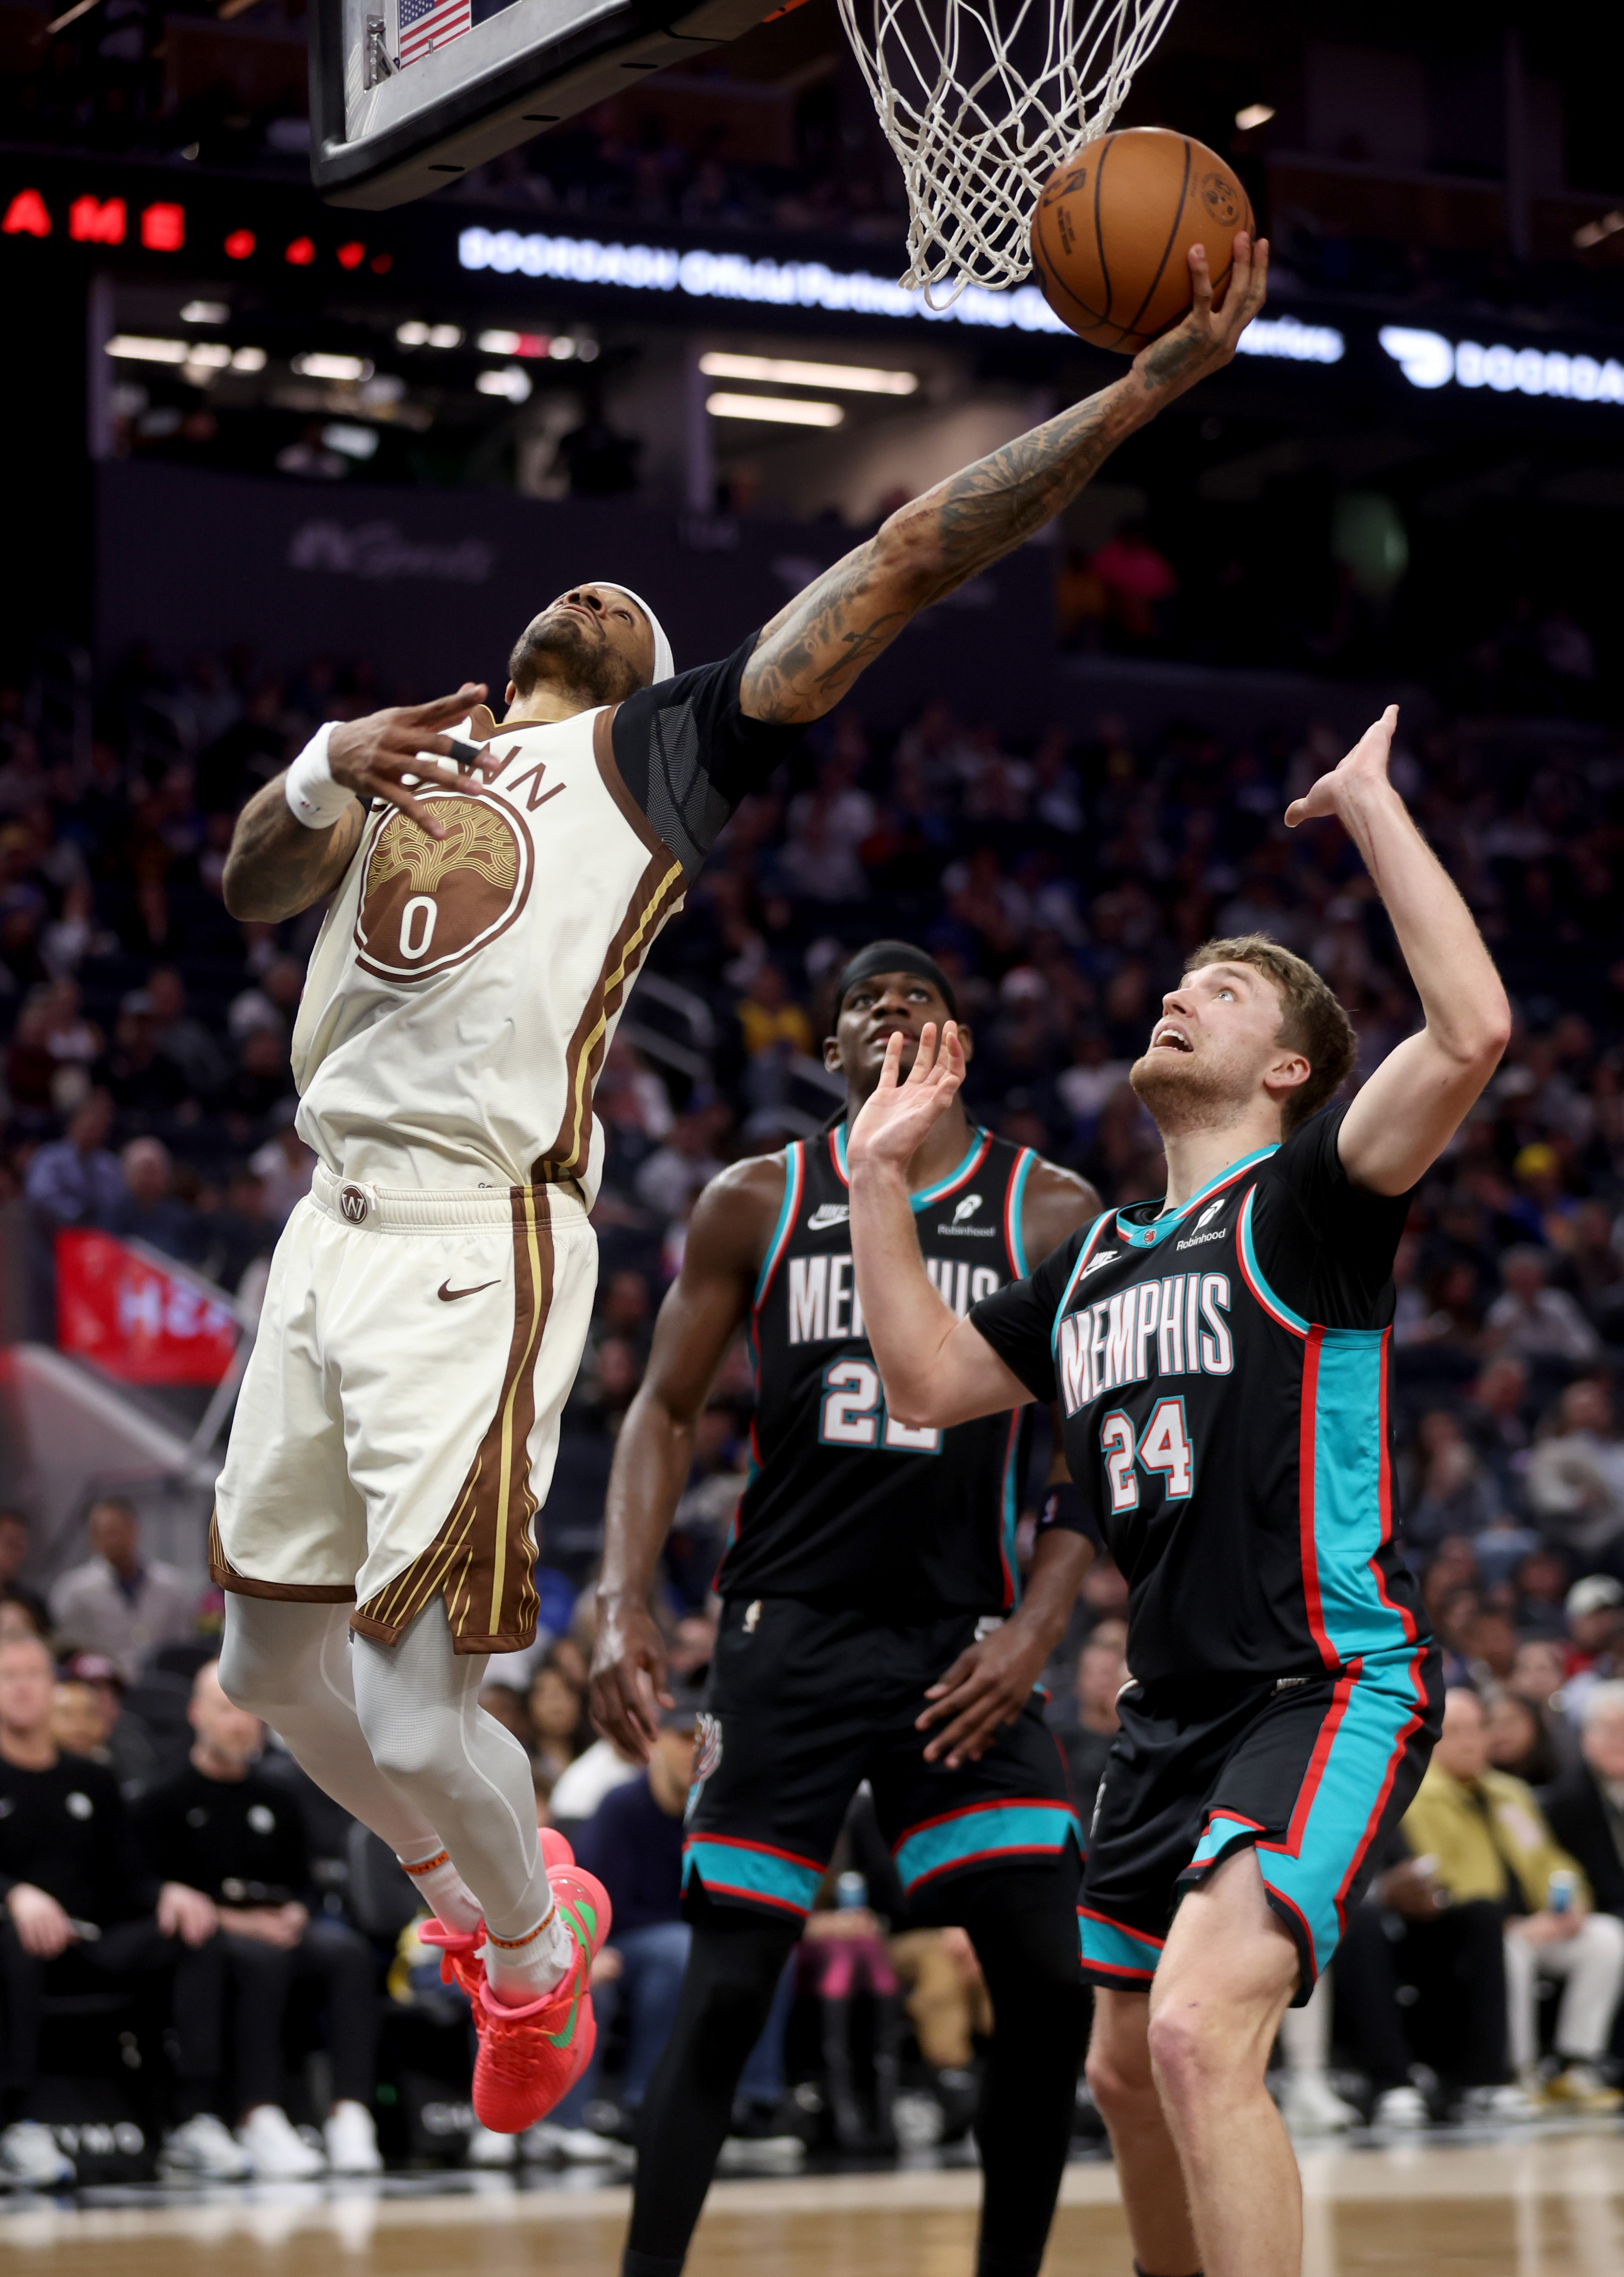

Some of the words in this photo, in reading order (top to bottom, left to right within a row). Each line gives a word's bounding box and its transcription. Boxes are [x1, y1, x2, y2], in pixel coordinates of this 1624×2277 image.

[400, 897, 437, 959] 0
[938, 1224, 996, 1237] Robinhood
[1176, 1228, 1226, 1251] Robinhood
[1088, 1250, 1118, 1268] NIKE
[1058, 1273, 1233, 1419] MEMPHIS
[1099, 1395, 1193, 1515] 24
